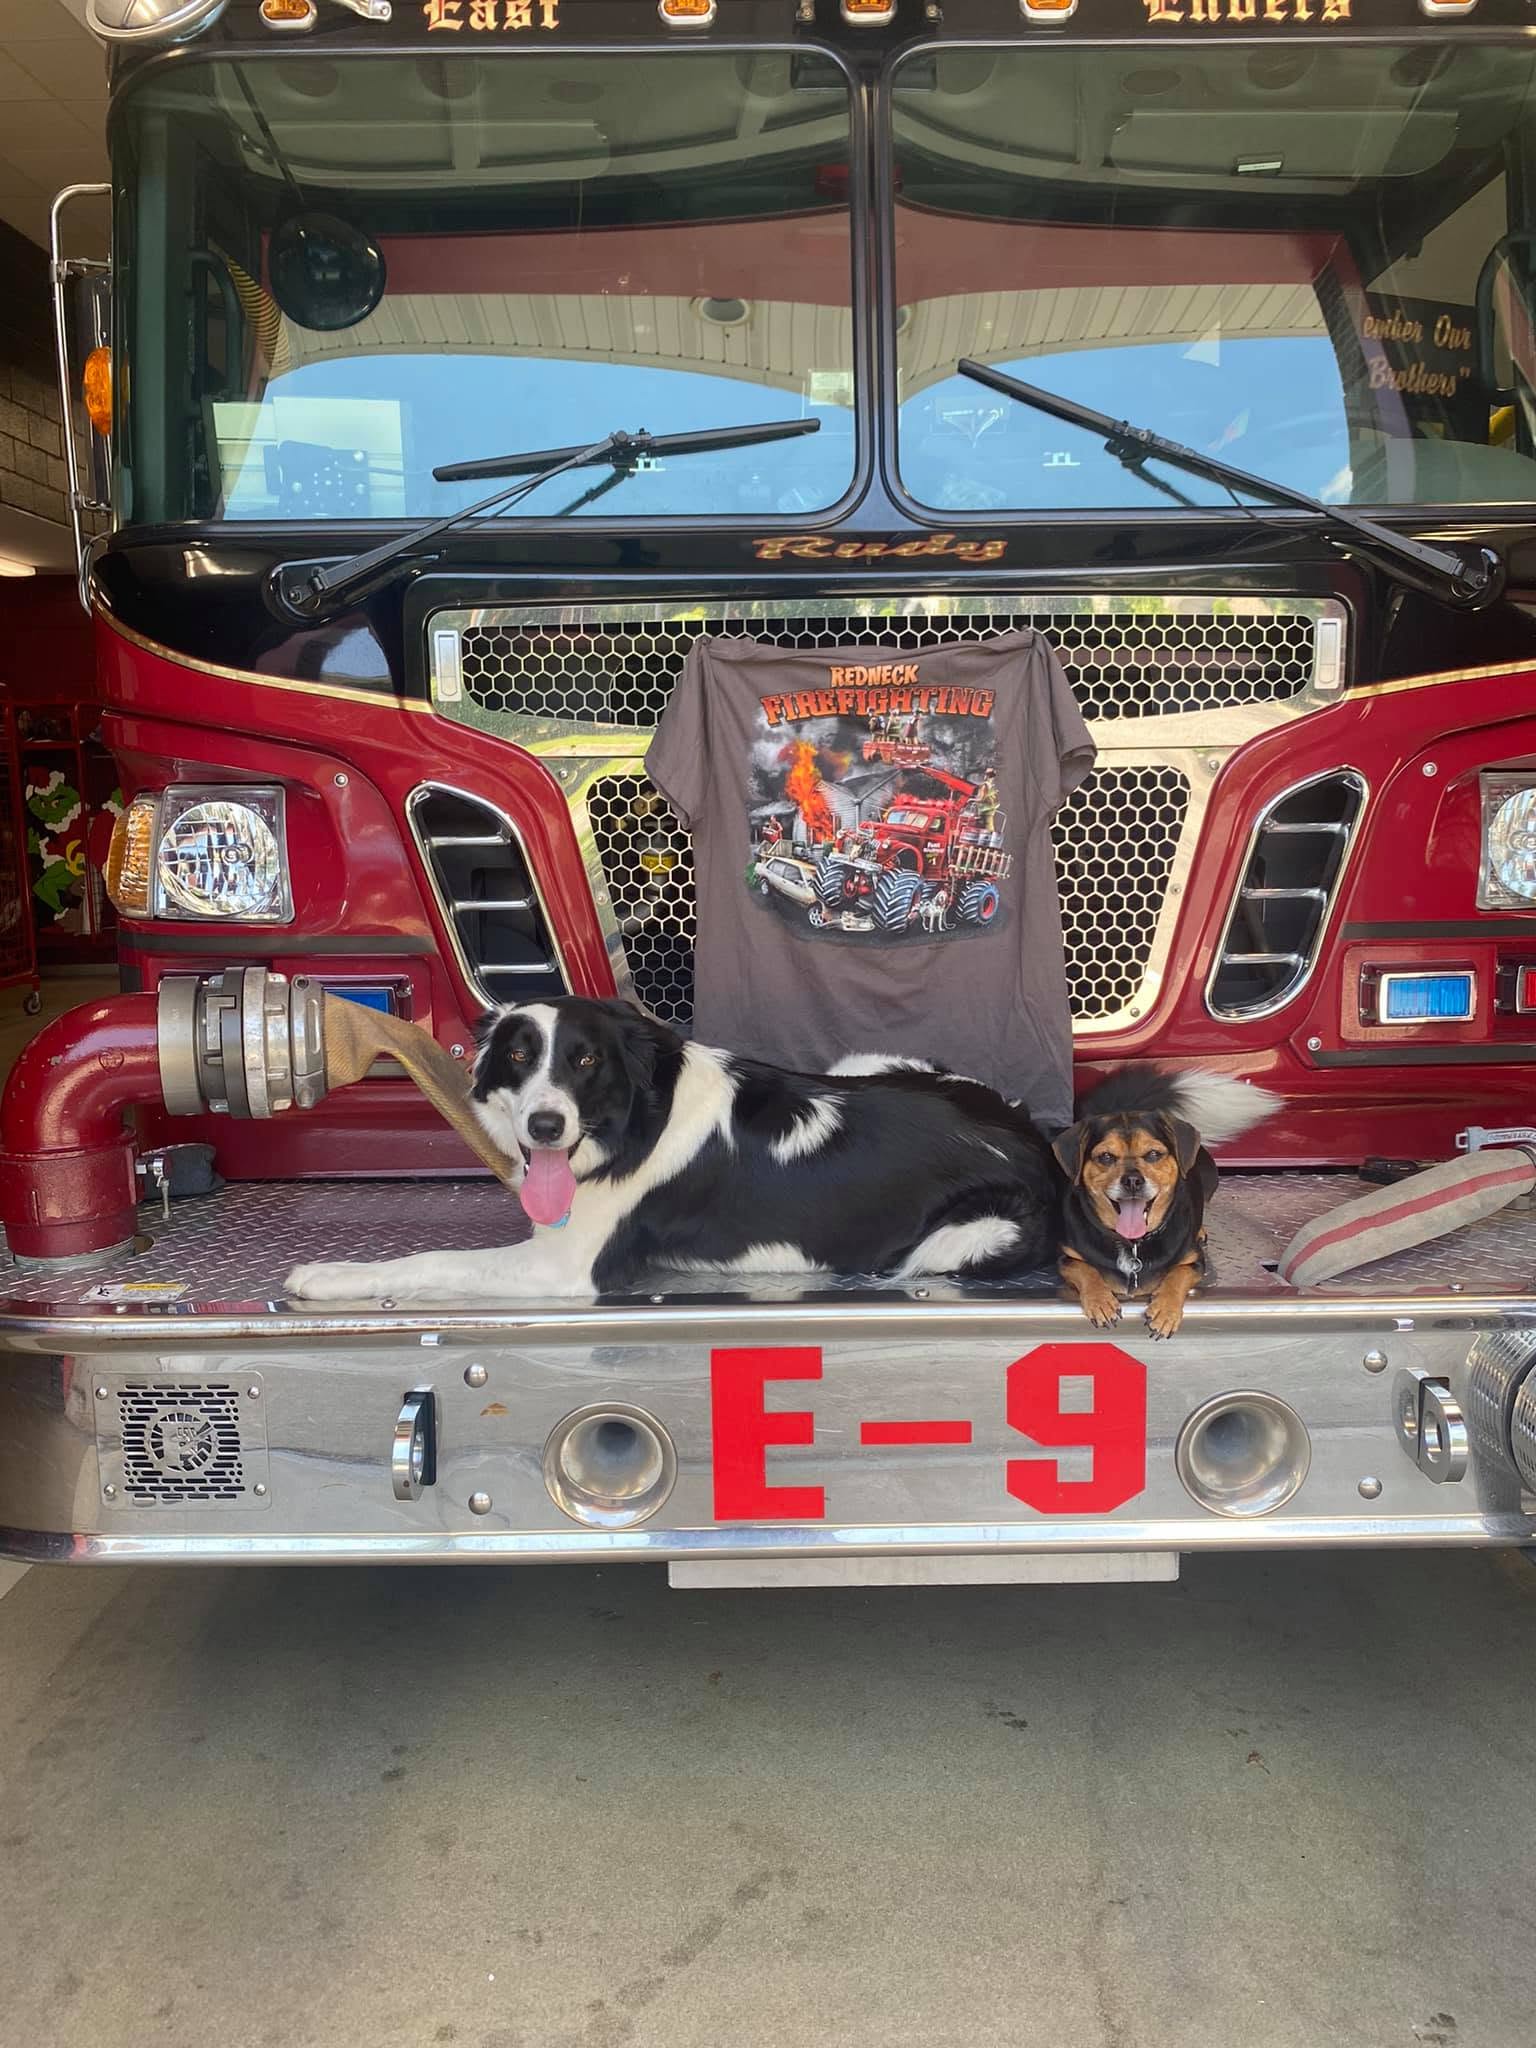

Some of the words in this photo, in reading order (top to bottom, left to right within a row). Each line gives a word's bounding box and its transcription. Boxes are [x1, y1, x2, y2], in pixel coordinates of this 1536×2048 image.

[423, 0, 560, 31] East
[1433, 314, 1472, 350] Our
[752, 533, 1008, 561] Rudy
[829, 664, 920, 688] REDNECK
[760, 686, 995, 727] FIREFIGHTING
